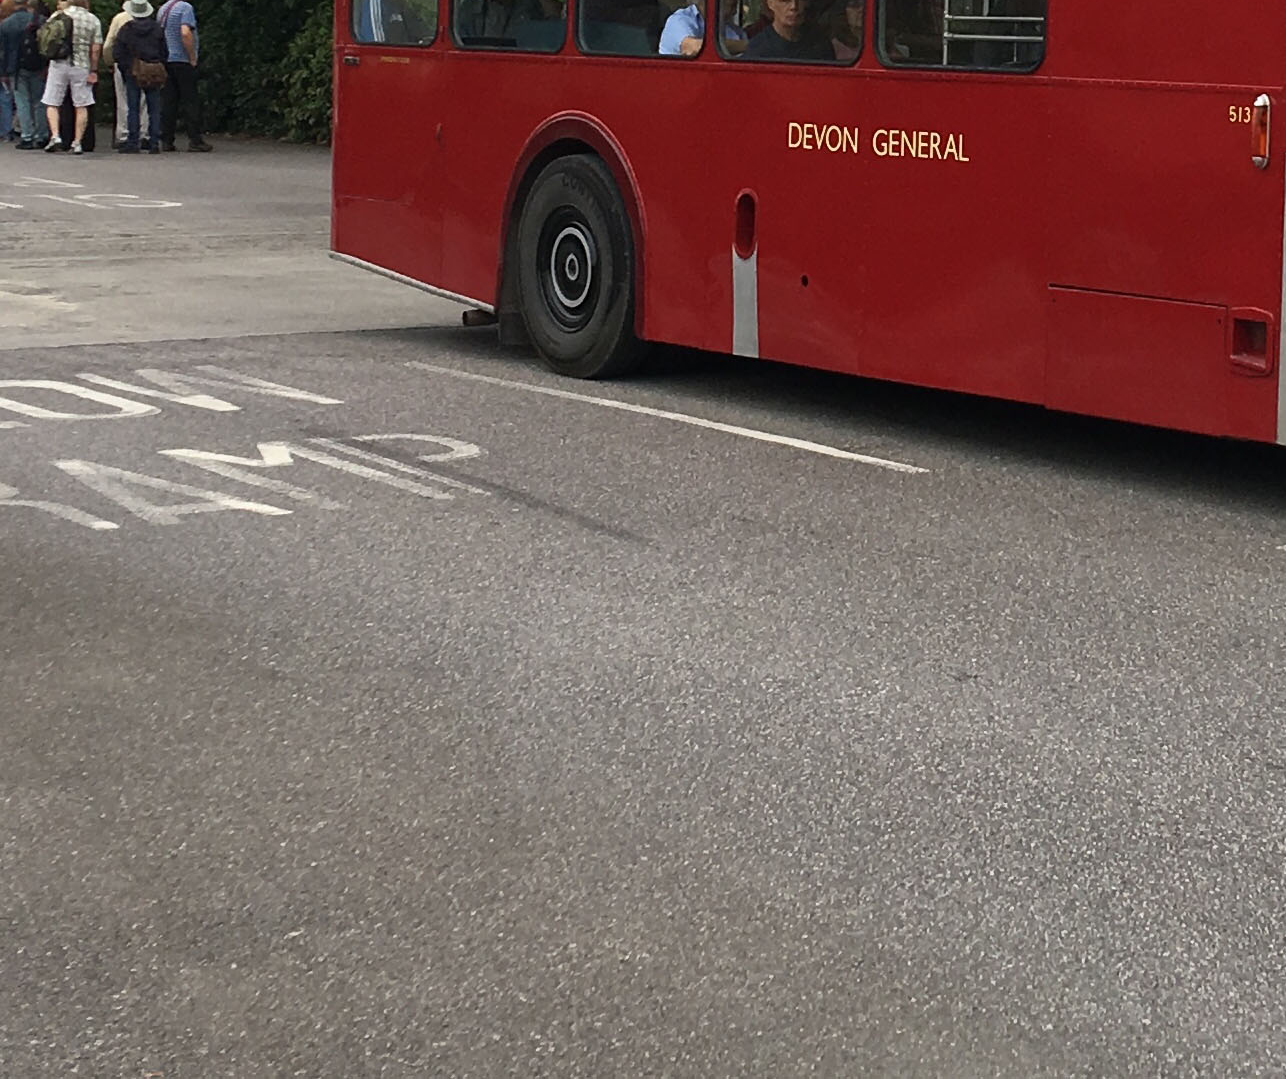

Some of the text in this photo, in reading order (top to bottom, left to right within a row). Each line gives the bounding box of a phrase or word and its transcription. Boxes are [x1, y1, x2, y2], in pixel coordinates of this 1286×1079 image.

[1229, 106, 1251, 123] 513
[788, 122, 970, 162] DEVON GENERAL
